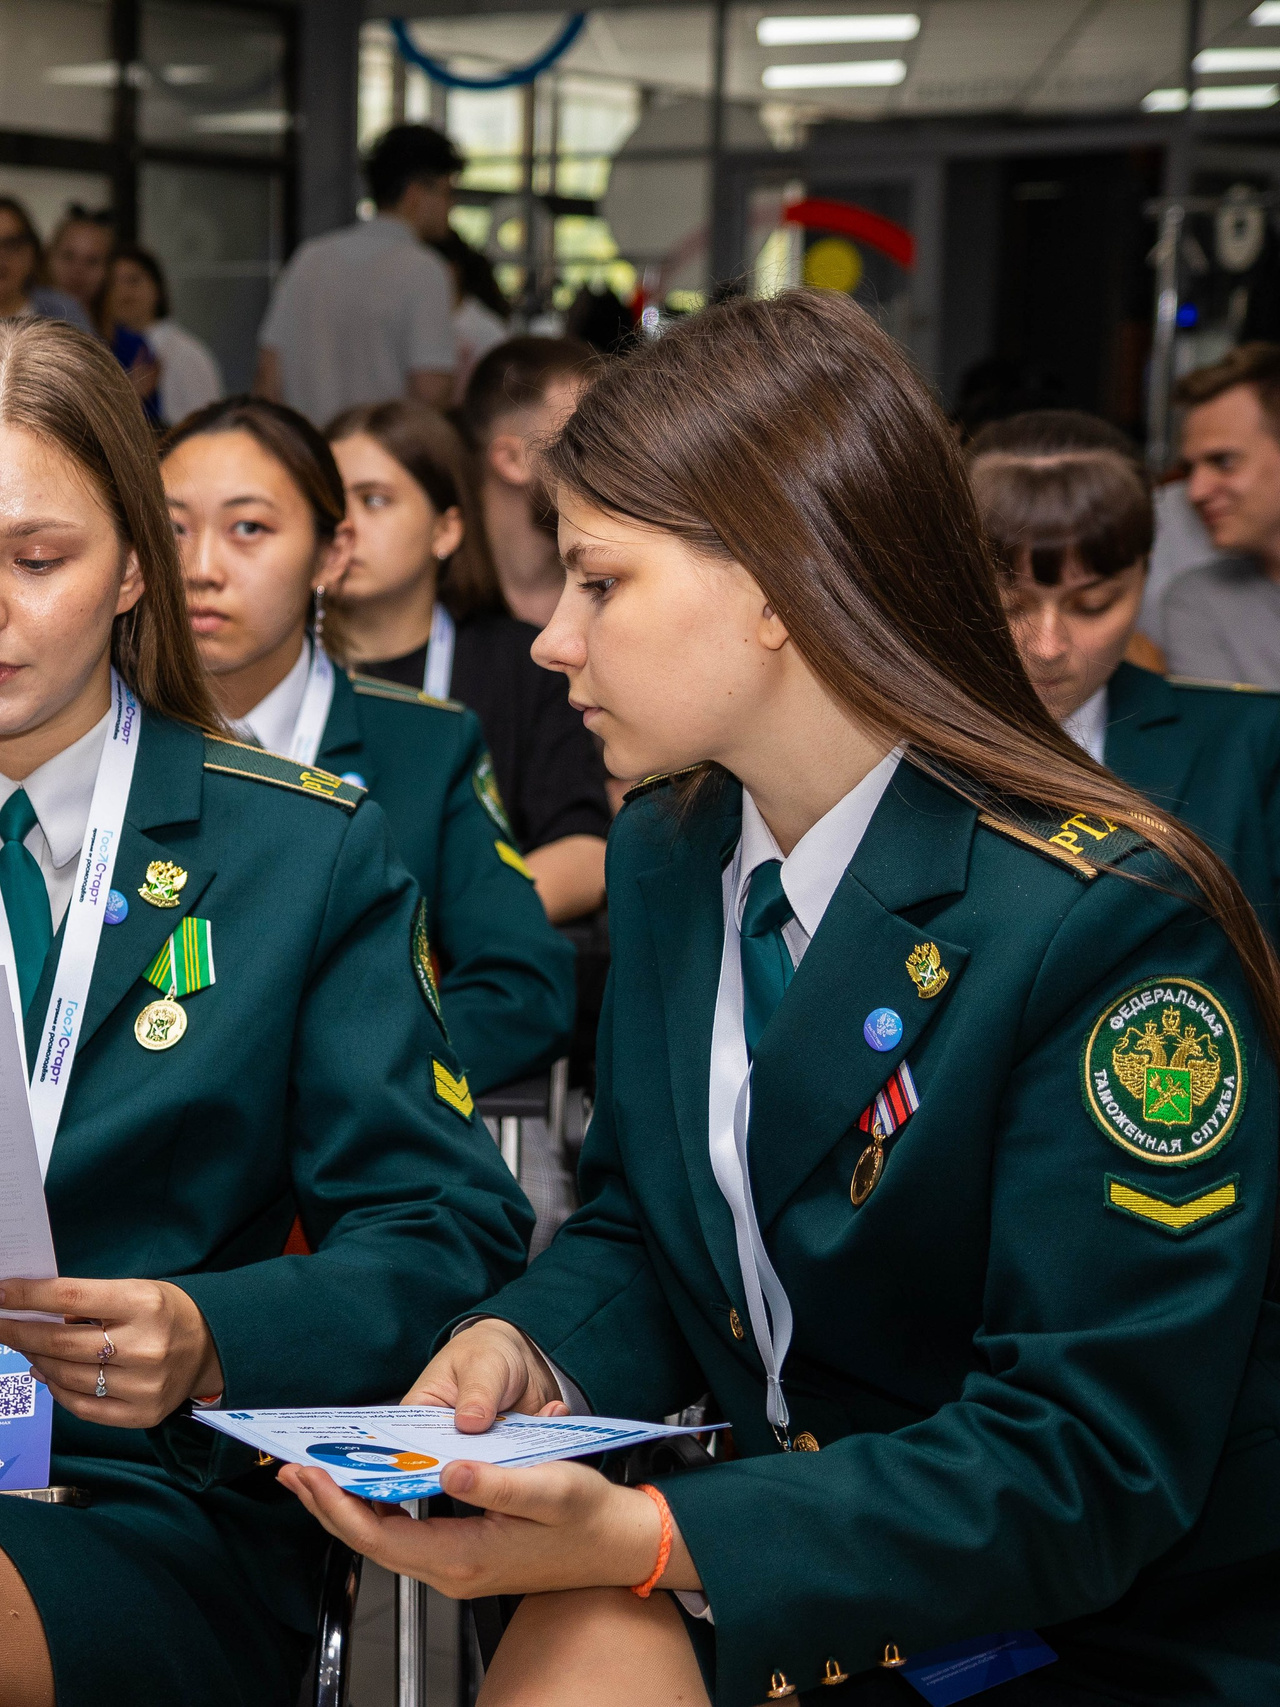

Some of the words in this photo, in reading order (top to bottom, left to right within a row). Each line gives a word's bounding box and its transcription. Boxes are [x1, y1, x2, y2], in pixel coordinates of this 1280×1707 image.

[1109, 988, 1224, 1038] ФЕДЕРАЛЬНАЯ
[1094, 1068, 1182, 1153] ТАМОЖЕННАЯ
[1191, 1075, 1235, 1146] СЛУЖБА
